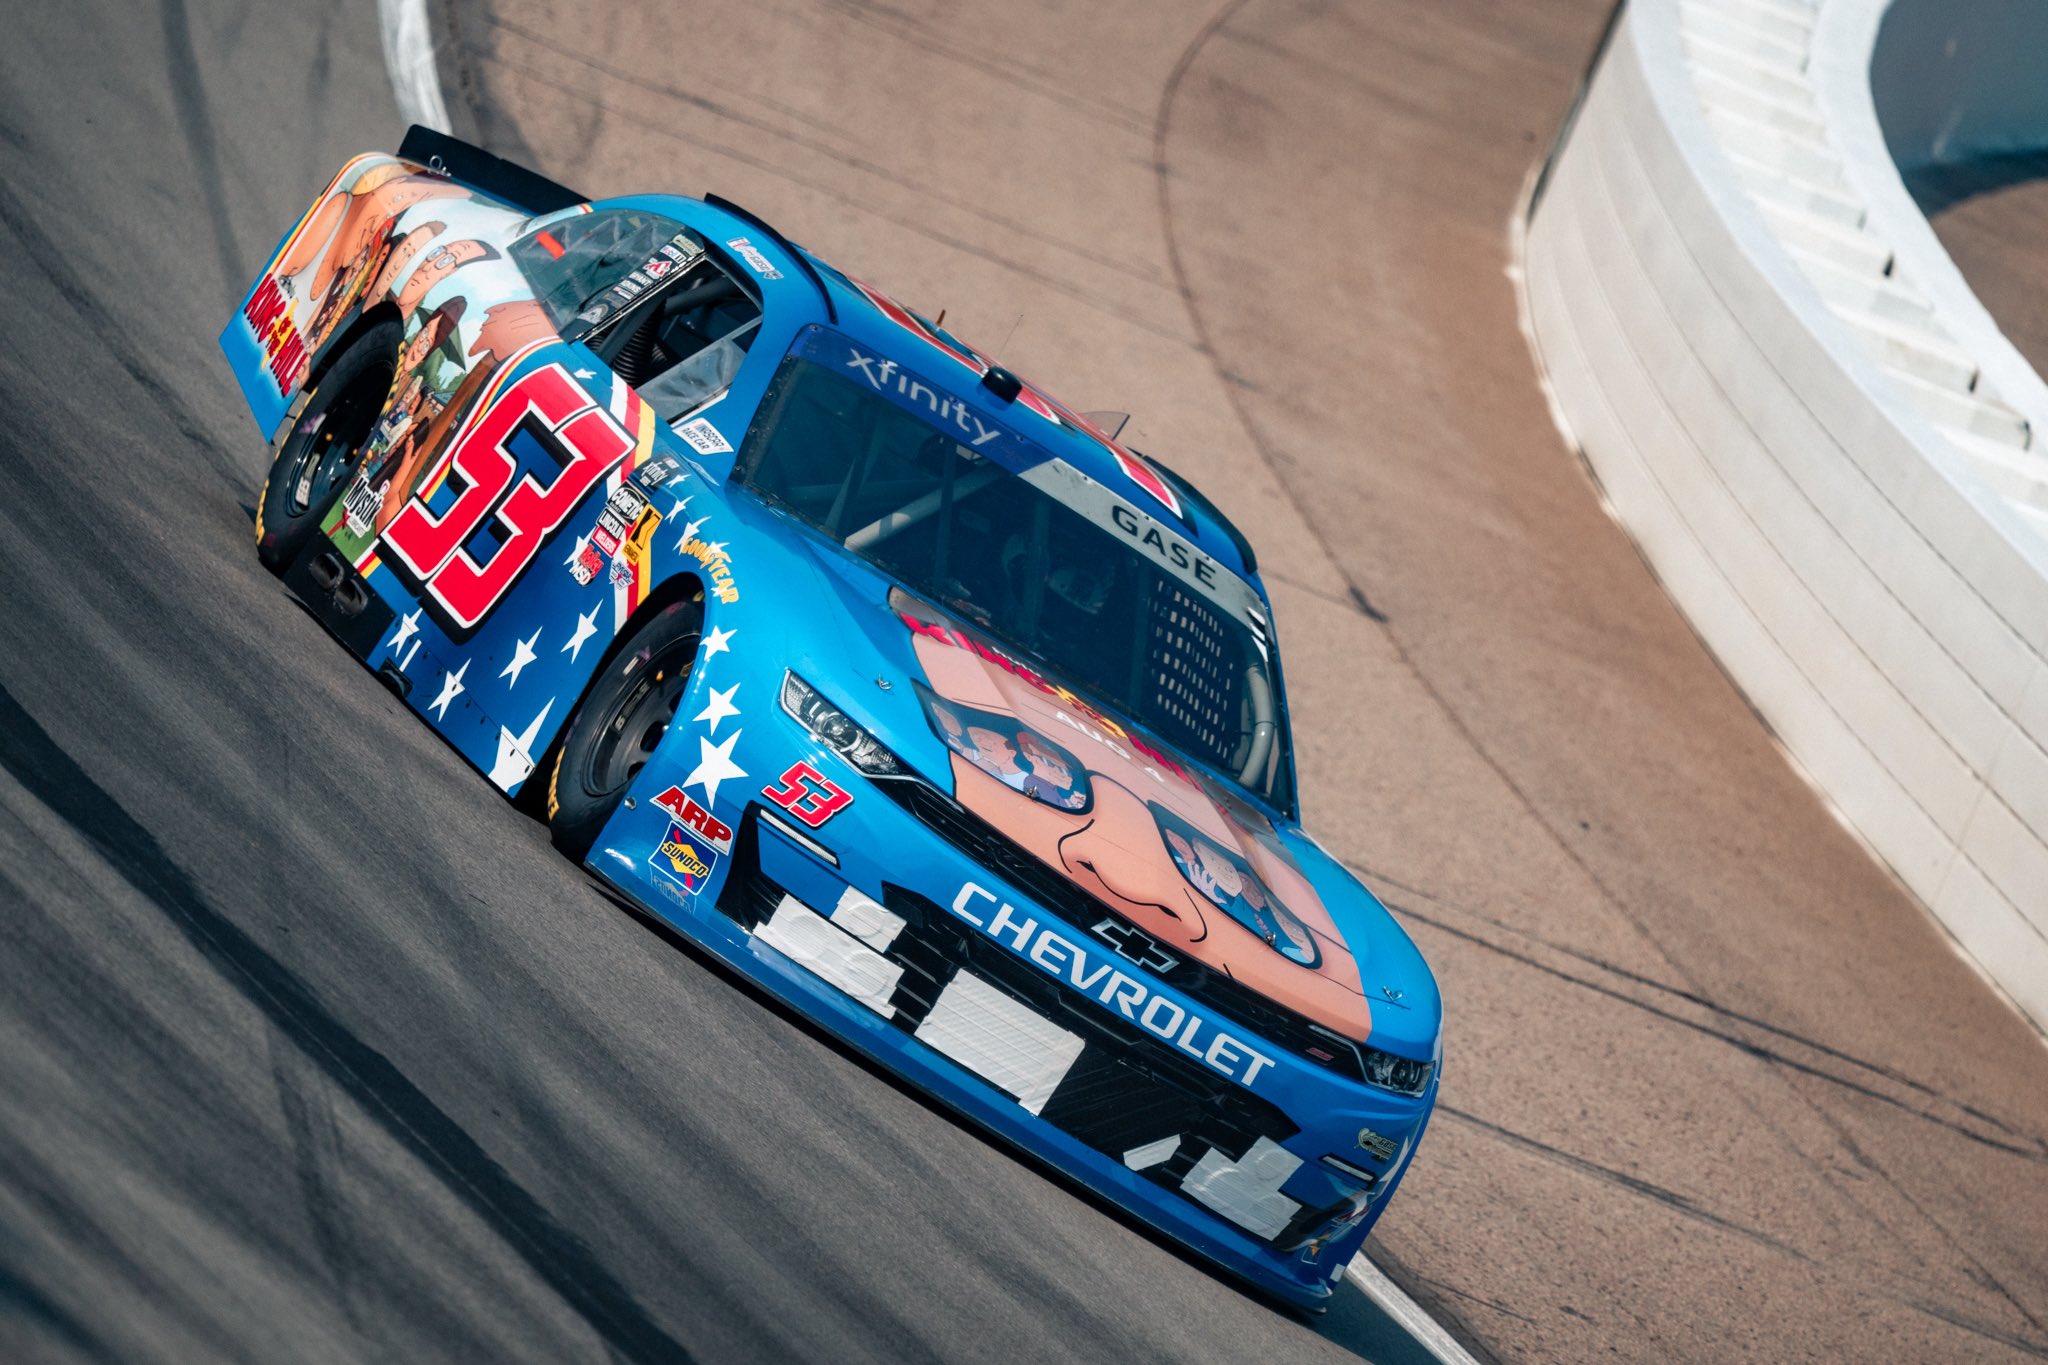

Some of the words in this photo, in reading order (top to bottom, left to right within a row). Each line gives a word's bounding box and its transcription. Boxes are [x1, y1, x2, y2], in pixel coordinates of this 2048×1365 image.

[244, 272, 286, 343] KING
[270, 327, 308, 399] HILL
[846, 348, 1000, 446] xfinity
[682, 427, 700, 440] RACE
[694, 438, 710, 450] CAR
[344, 477, 382, 528] Mystik
[380, 362, 638, 629] 53
[598, 510, 626, 539] LINCOLN
[611, 487, 645, 521] COMETIC
[568, 561, 593, 586] MSD
[595, 530, 617, 553] WELDERS
[681, 537, 739, 604] GOODYEAR
[1111, 505, 1217, 590] GASE
[1056, 711, 1131, 760] AUG
[1144, 766, 1165, 782] 4
[655, 786, 732, 844] ARP
[761, 760, 854, 827] 53
[663, 843, 707, 877] SUNOCO
[952, 882, 1275, 1087] CHEVROLET
